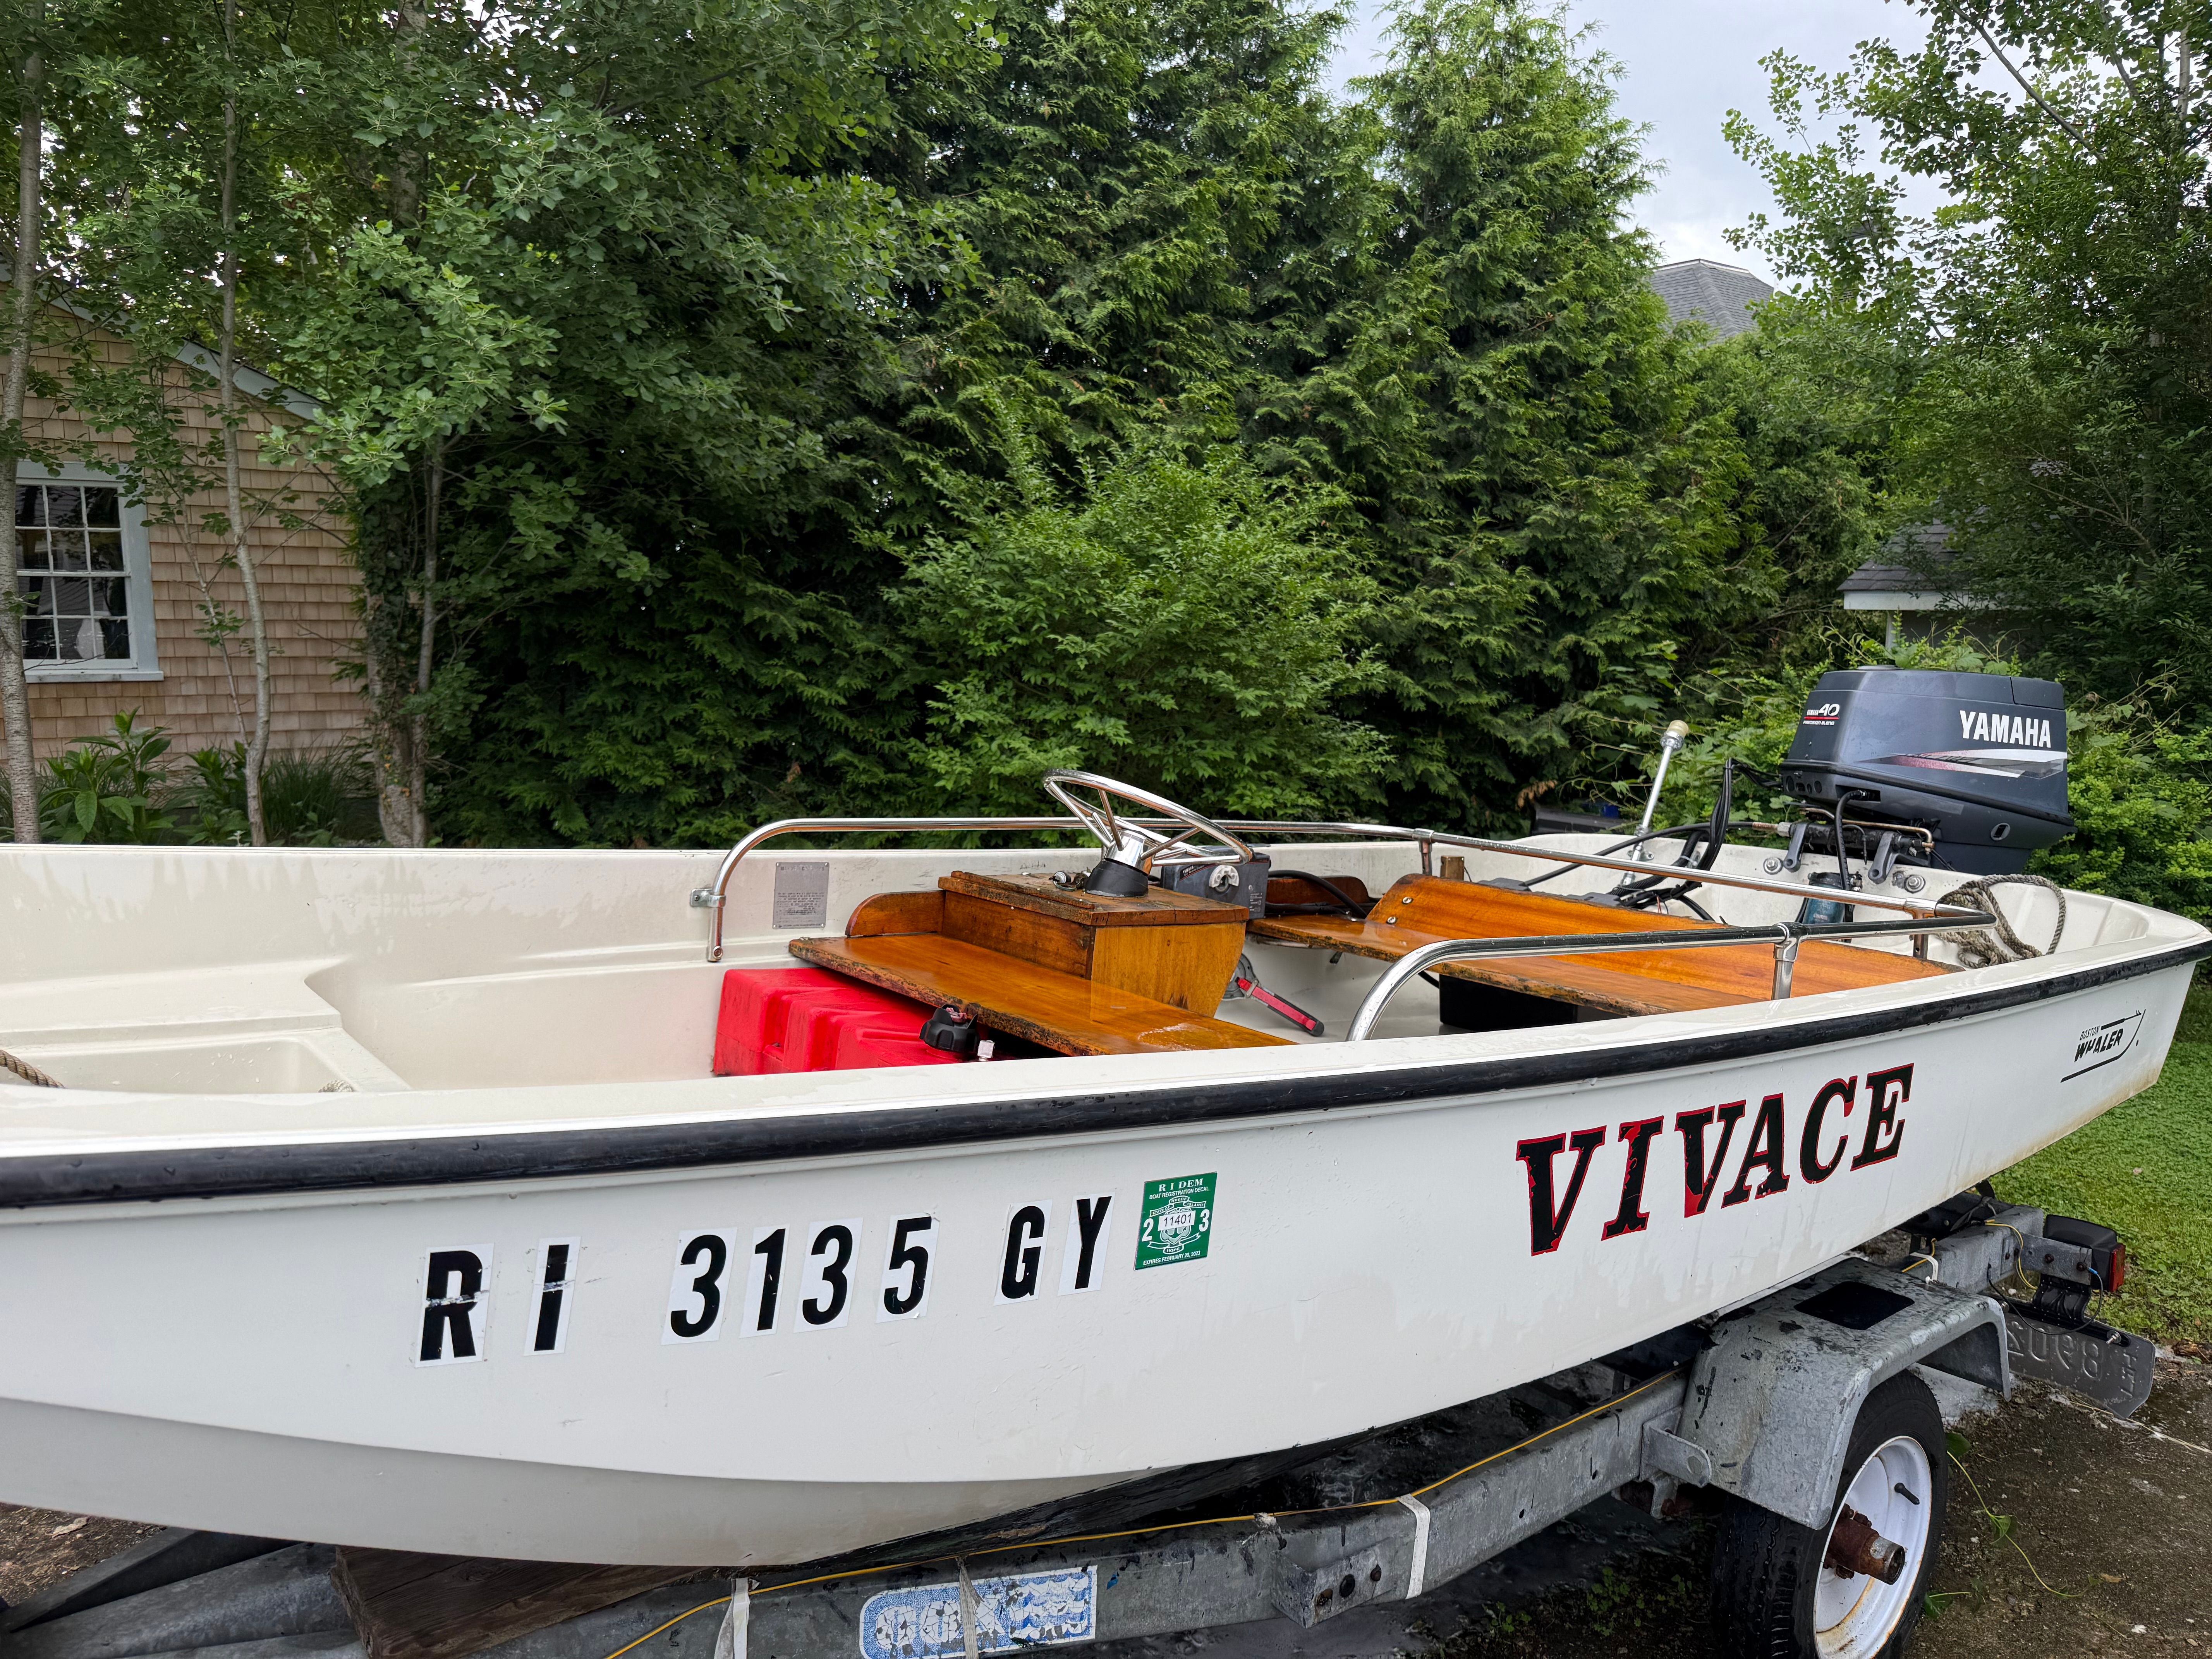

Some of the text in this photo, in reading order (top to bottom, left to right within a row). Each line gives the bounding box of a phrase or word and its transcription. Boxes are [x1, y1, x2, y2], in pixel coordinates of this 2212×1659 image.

[1819, 703, 1840, 716] 40
[1960, 710, 2051, 748] YAMAHA
[2080, 1025, 2100, 1041] BOSTON
[2074, 1028, 2123, 1063] WHALER
[1516, 1063, 1914, 1256] VIVACE
[1162, 1188, 1194, 1197] REGISTRATION
[1178, 1178, 1204, 1189] DEM
[1142, 1209, 1210, 1242] 2 11401 3
[670, 1216, 932, 1338] 3135
[1001, 1196, 1112, 1299] GY
[1143, 1257, 1161, 1266] EXPIRES
[1161, 1253, 1184, 1262] FEBRUARY
